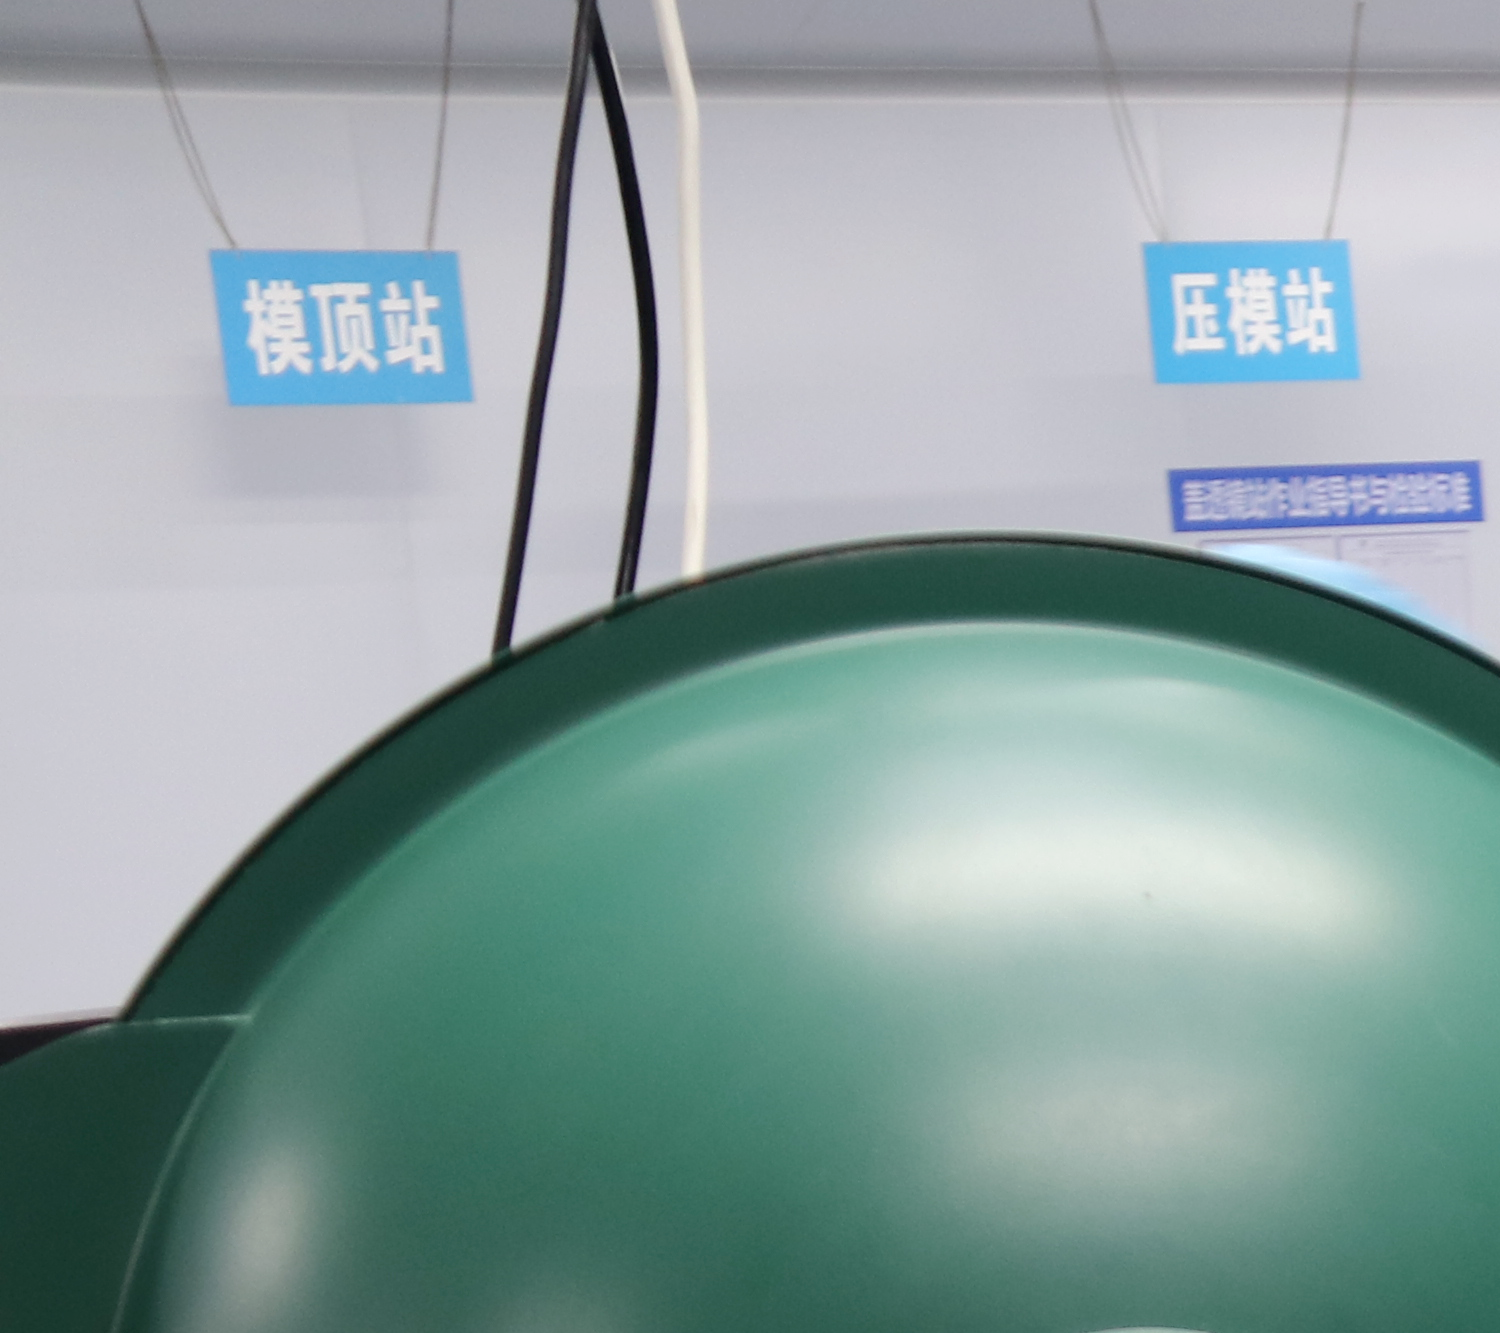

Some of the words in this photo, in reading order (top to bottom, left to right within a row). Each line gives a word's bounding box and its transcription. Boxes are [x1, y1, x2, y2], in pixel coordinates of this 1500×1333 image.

[243, 279, 445, 376] 模顶站
[1171, 267, 1337, 356] 压模站
